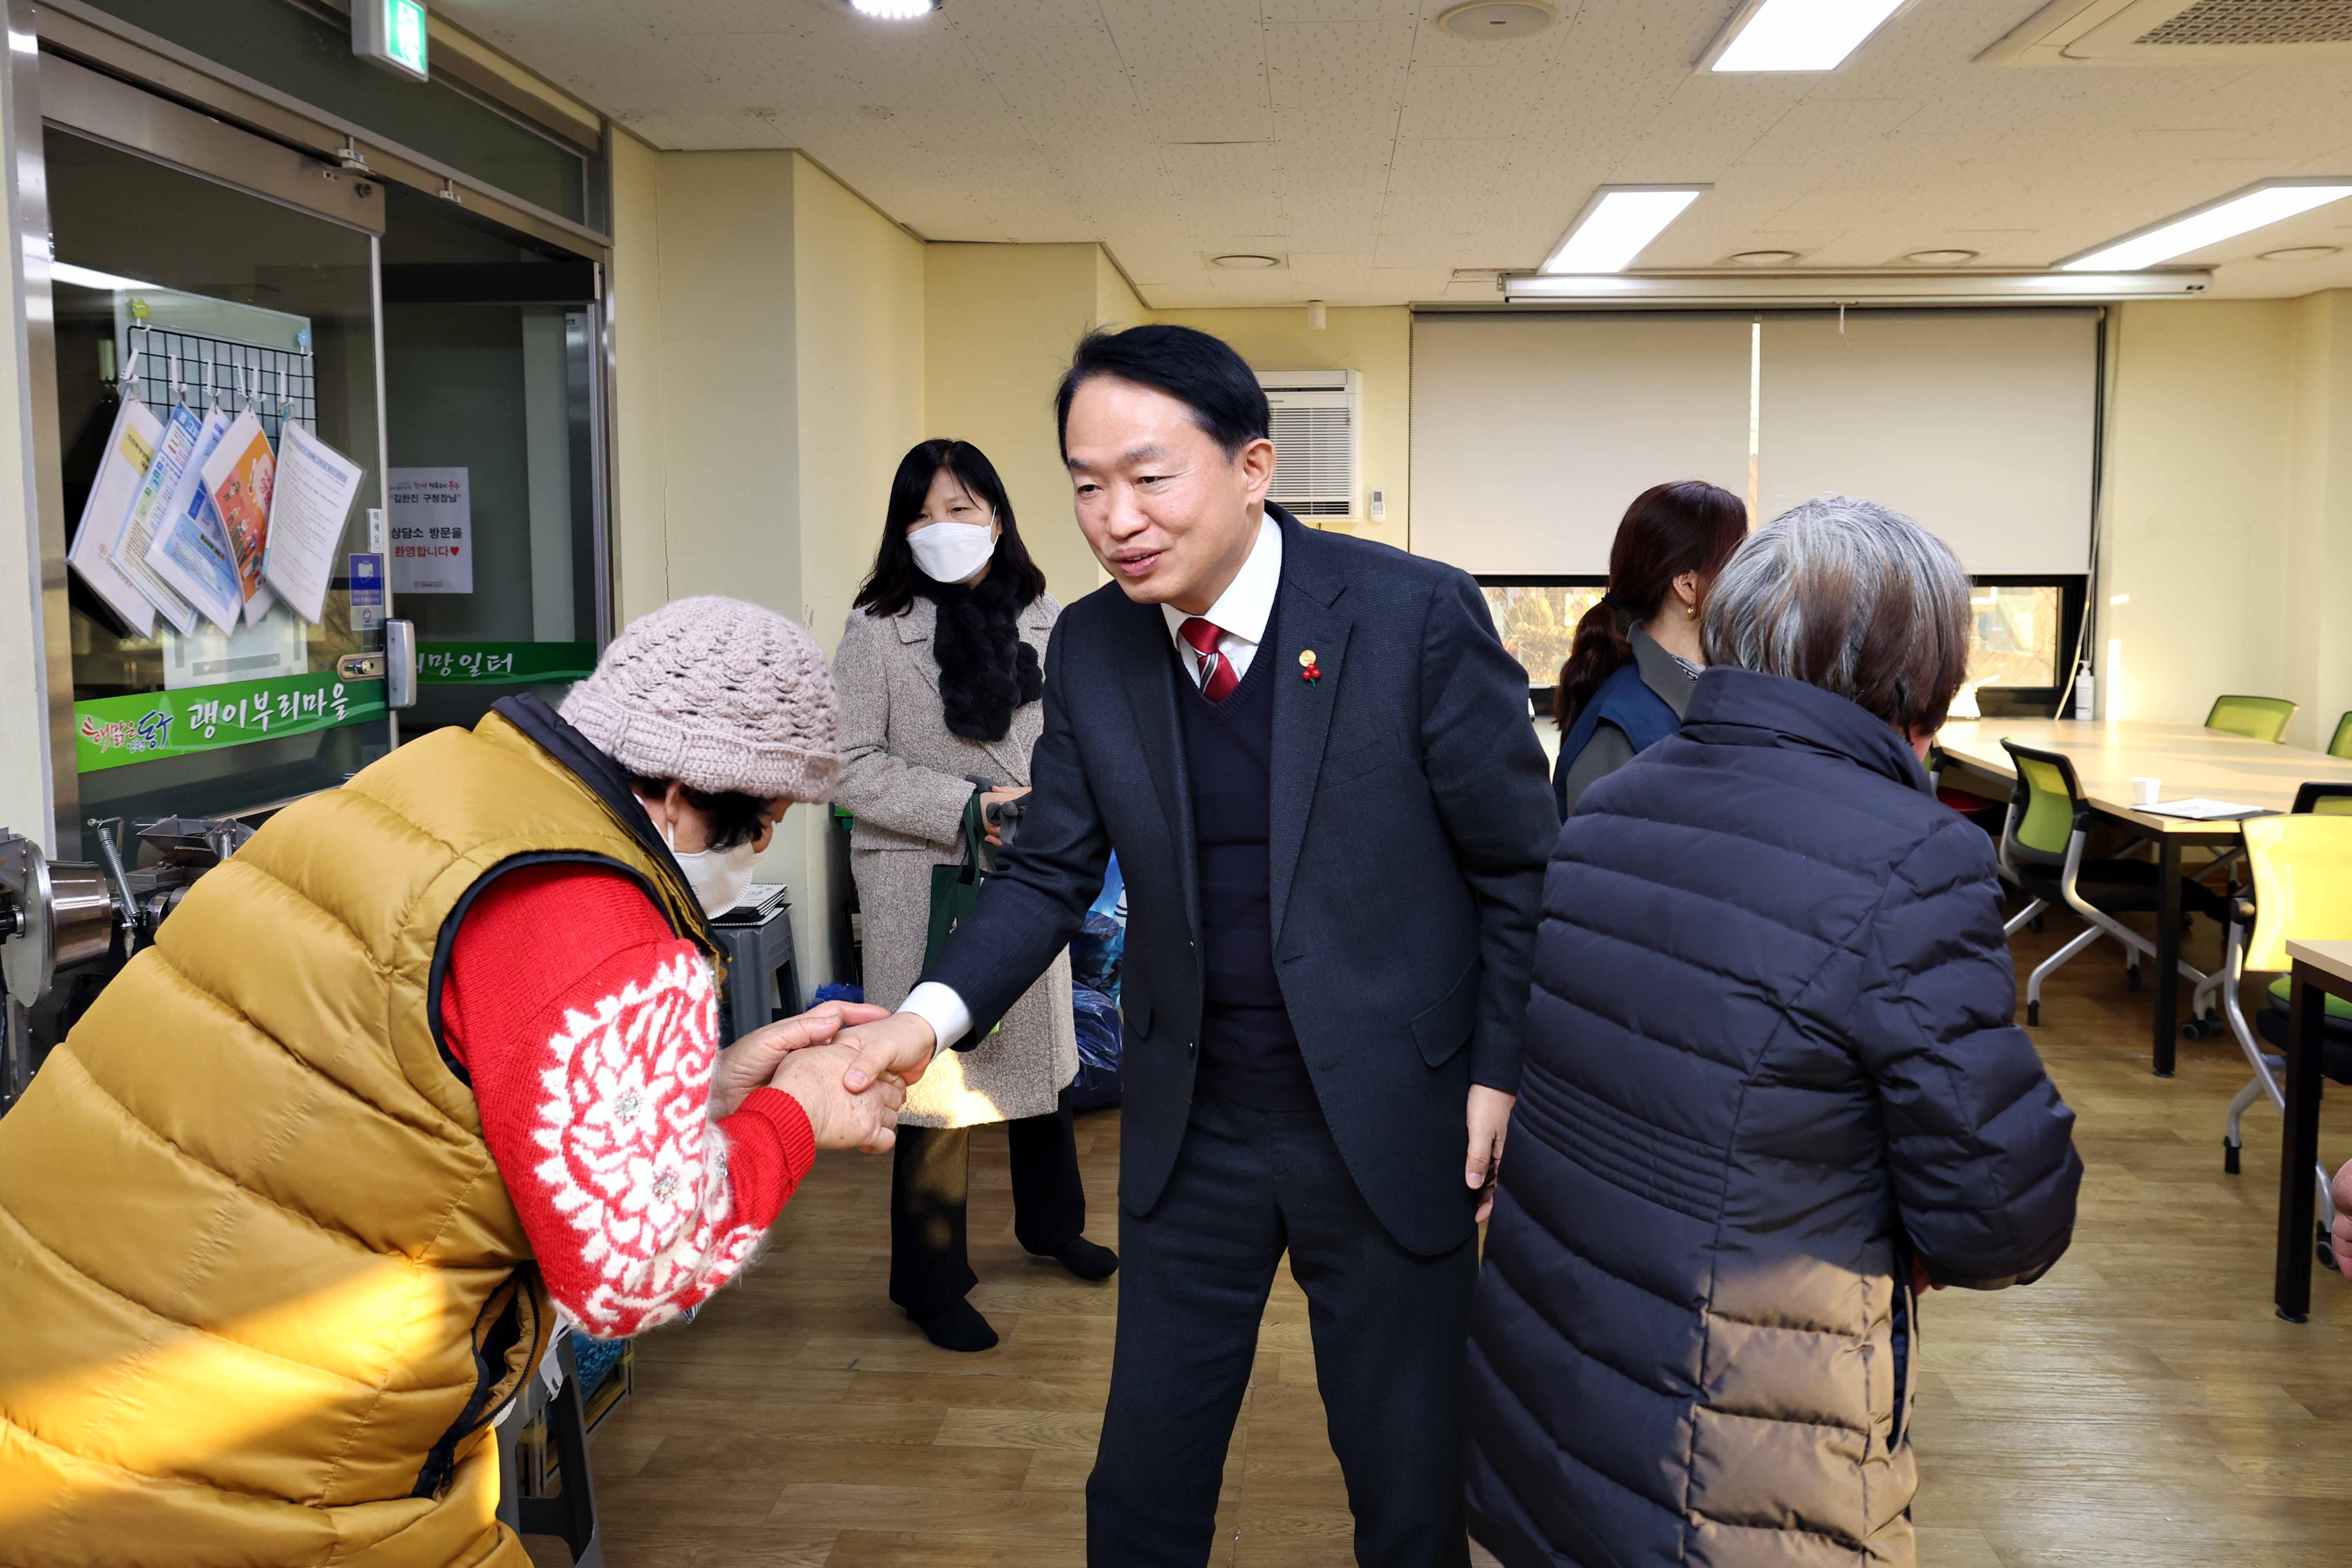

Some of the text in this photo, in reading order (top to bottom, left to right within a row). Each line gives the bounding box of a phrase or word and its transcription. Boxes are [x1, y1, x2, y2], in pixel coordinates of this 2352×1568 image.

[391, 527, 462, 539] 상담소 방문을
[395, 546, 449, 557] 환영합니다
[138, 710, 174, 749] 동구
[187, 683, 350, 739] 괭이부리마을
